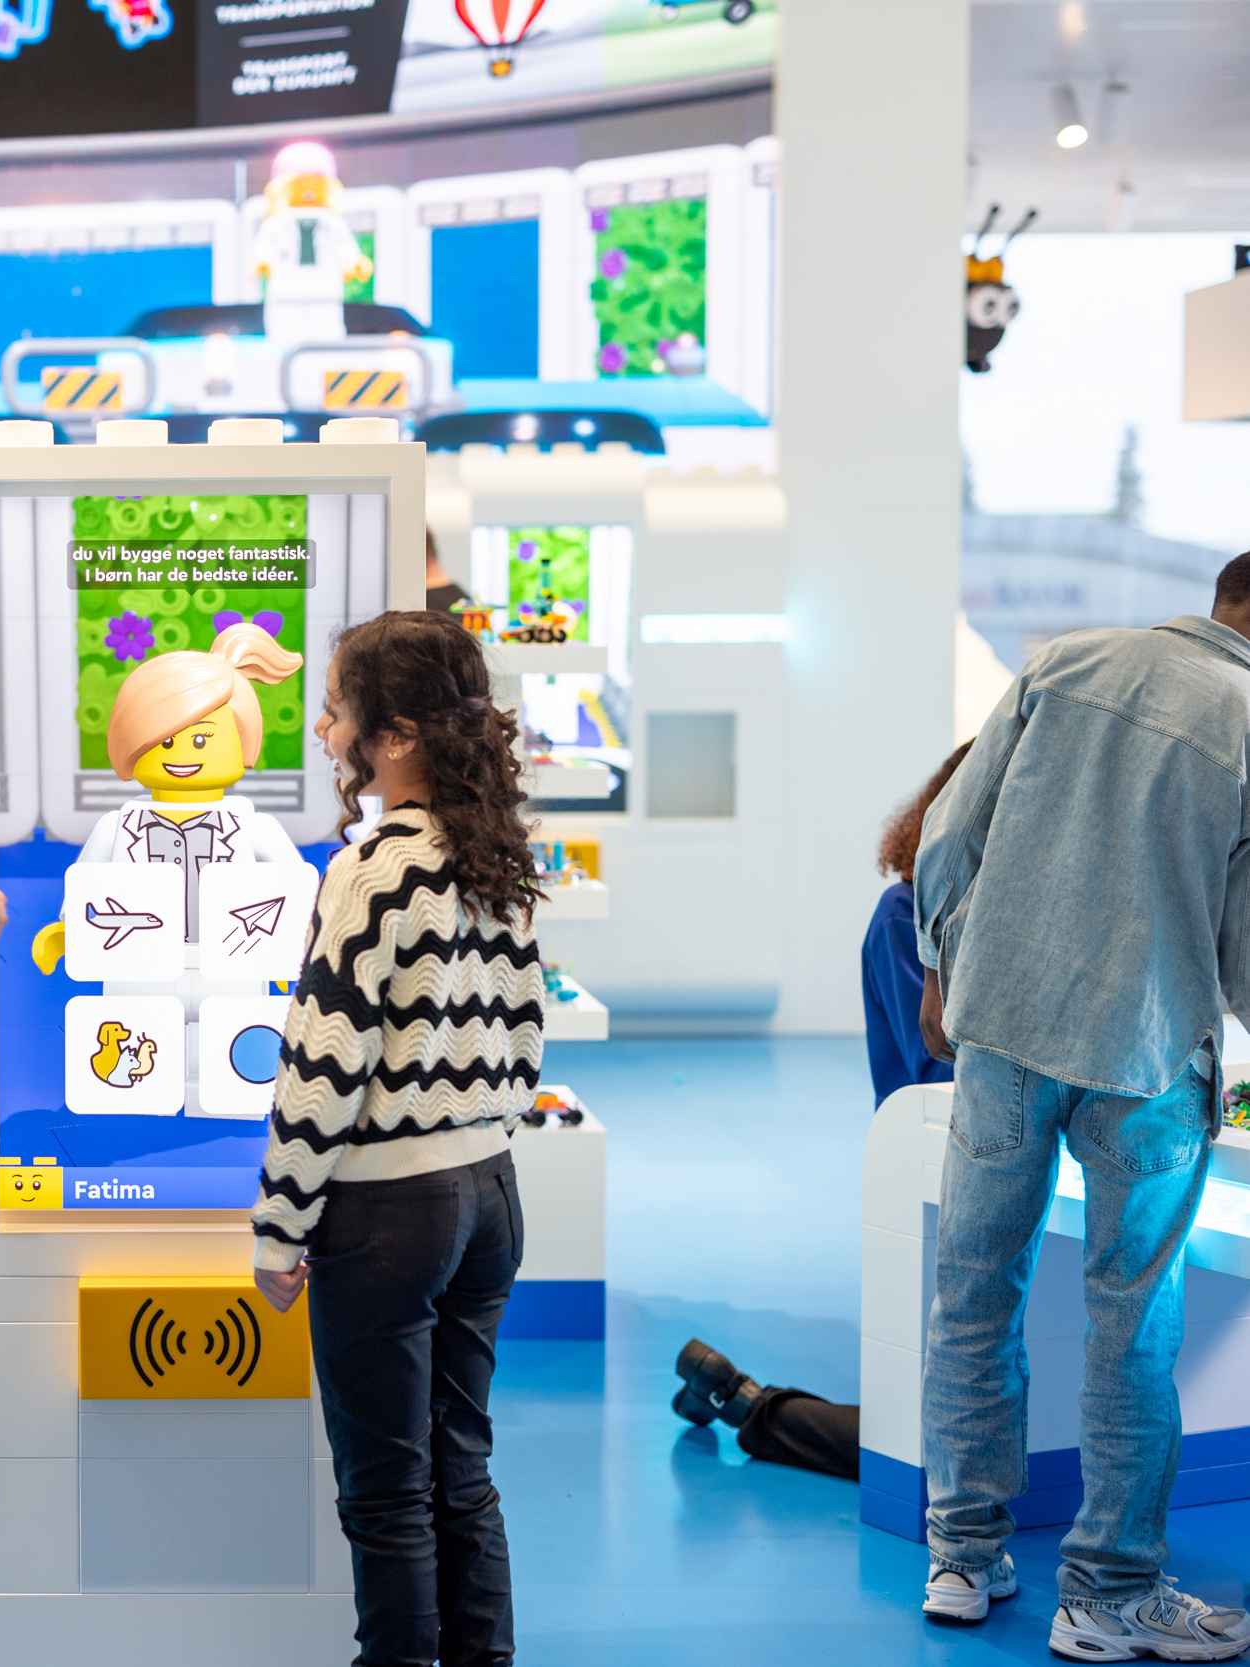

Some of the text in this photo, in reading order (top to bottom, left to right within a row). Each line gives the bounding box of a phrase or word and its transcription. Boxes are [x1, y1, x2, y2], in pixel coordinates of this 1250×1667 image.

[72, 545, 311, 563] du vil bygge noget fantastisk.
[85, 565, 299, 582] I børn har de bedste idéer.
[74, 1178, 155, 1200] Fatima
